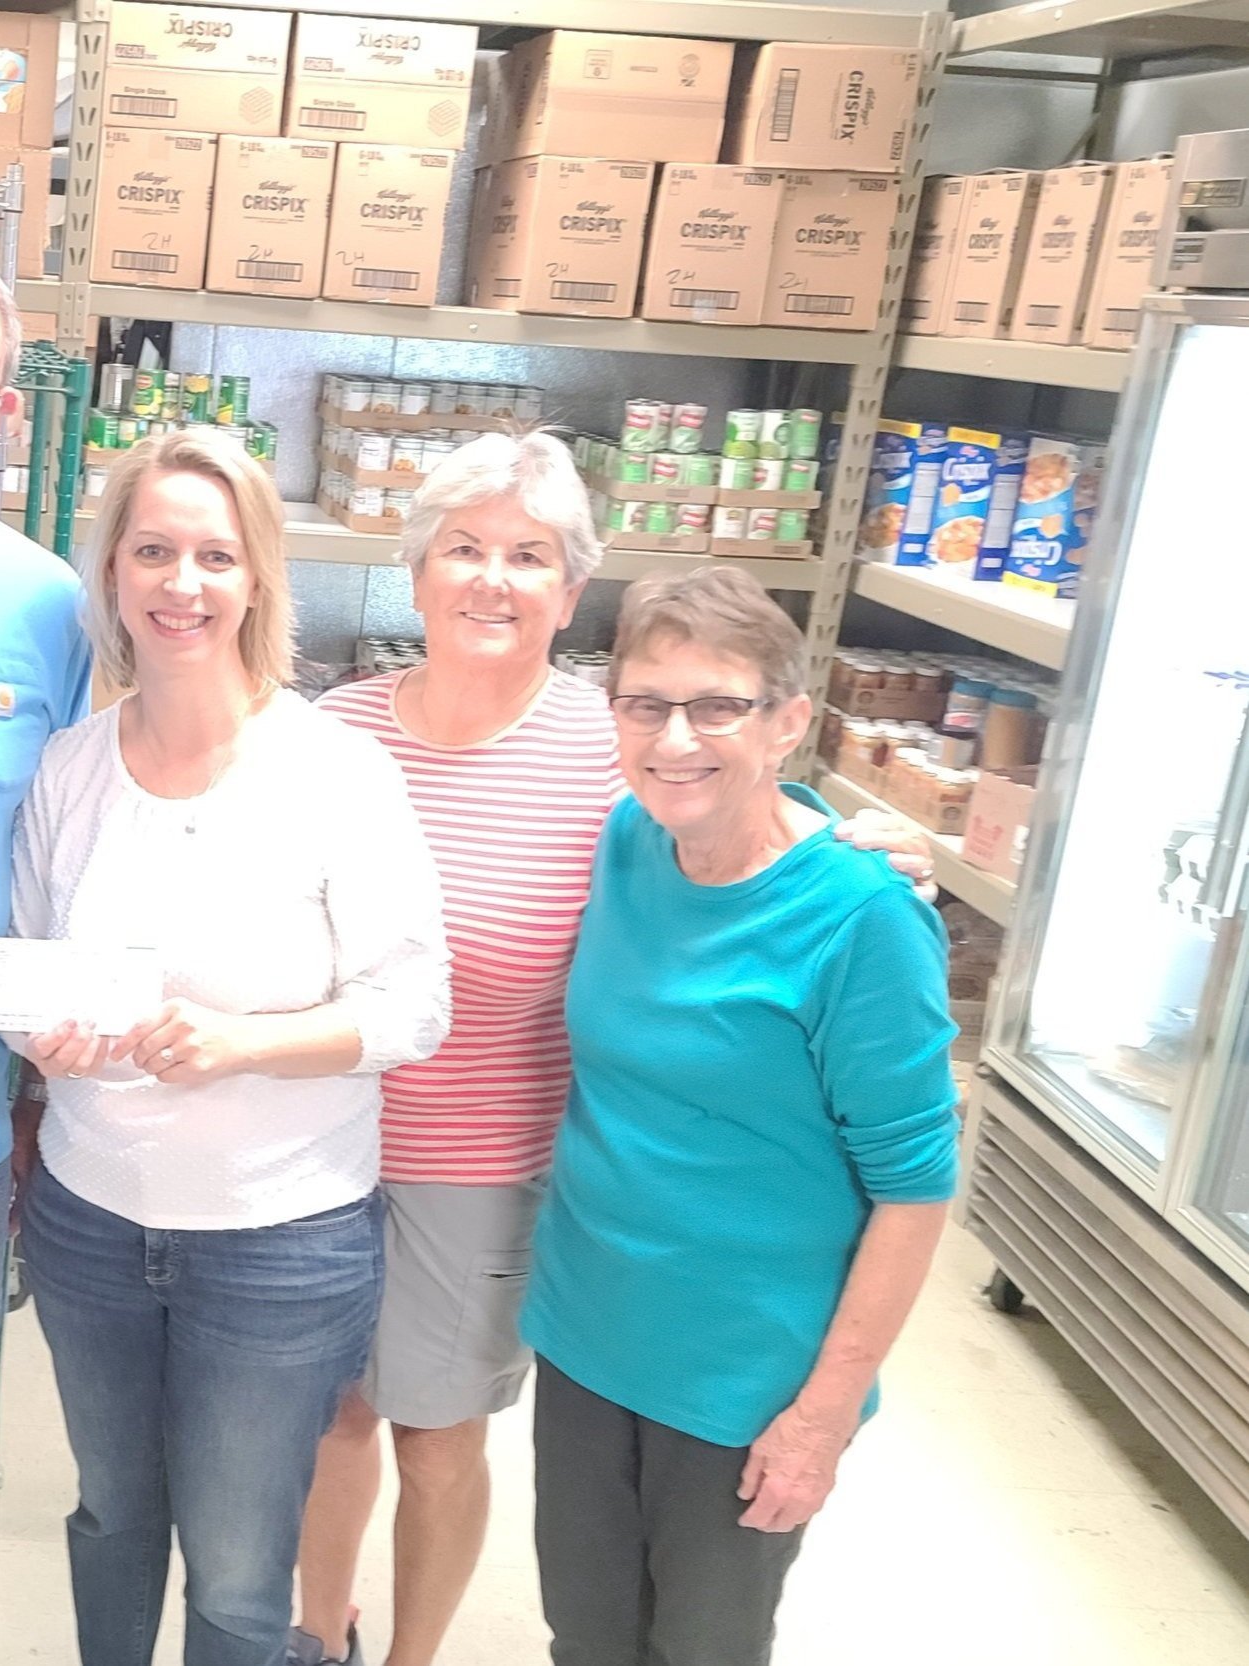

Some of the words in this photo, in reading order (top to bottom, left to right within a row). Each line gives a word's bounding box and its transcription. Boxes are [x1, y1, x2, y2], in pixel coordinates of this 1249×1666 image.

[164, 19, 233, 38] CRISPIX
[356, 33, 421, 51] CRISPIX
[840, 70, 864, 140] CRISPIX
[117, 185, 180, 204] CRISPIX
[242, 194, 305, 213] CRISPIX
[360, 203, 423, 221] CRISPIX
[560, 216, 622, 233] CRISPIX
[680, 223, 746, 240] CRISPIX
[795, 228, 860, 245] CRISPIX
